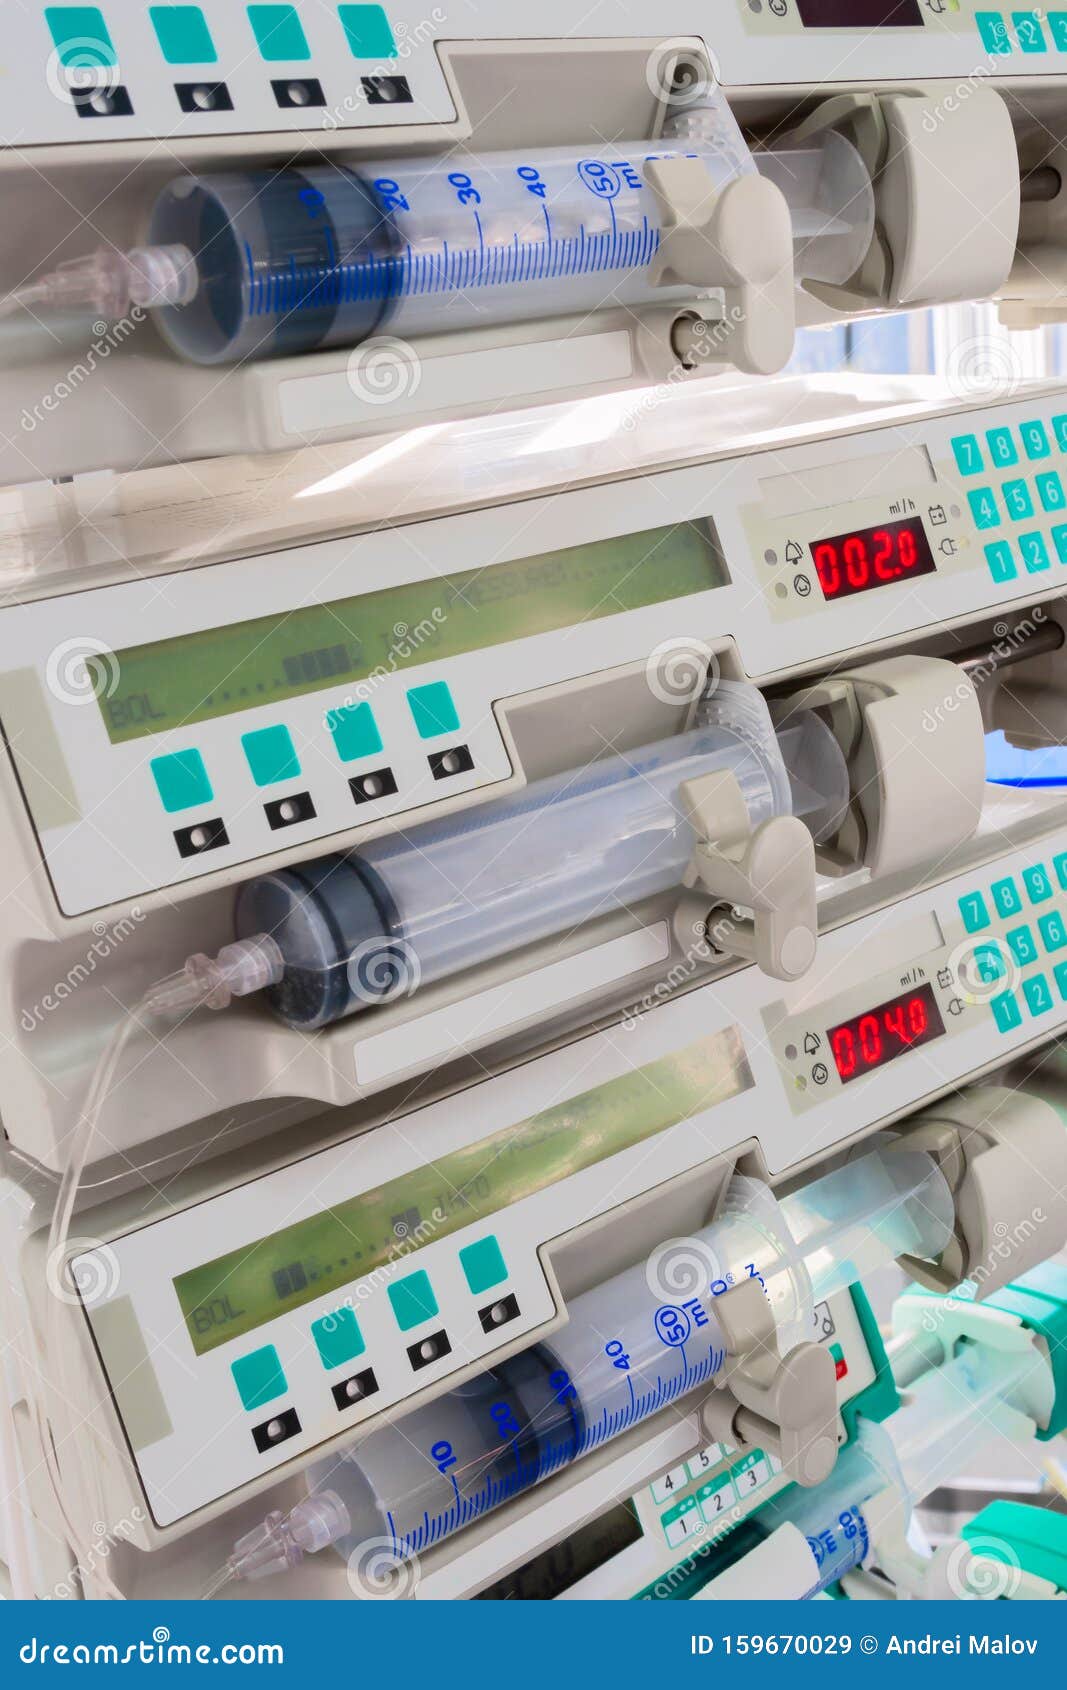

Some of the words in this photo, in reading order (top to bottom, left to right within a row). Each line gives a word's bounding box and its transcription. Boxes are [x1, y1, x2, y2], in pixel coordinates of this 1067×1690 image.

[448, 172, 481, 205] 30
[517, 166, 547, 198] 40
[584, 162, 615, 193] 50
[611, 162, 643, 189] ml
[373, 178, 410, 211] 20
[961, 443, 973, 467] 7
[996, 436, 1011, 459] 8
[1029, 428, 1044, 452] 9
[980, 497, 993, 520] 4
[1012, 488, 1026, 512] 5
[1045, 480, 1060, 504] 6
[814, 529, 918, 594] 002.0
[995, 551, 1007, 574] 1
[1029, 541, 1043, 565] 2
[967, 901, 979, 924] 7
[1001, 886, 1014, 909] 8
[1031, 873, 1046, 895] 9
[1016, 935, 1030, 958] 5
[1047, 920, 1061, 943] 6
[1001, 1000, 1012, 1022] 1
[1032, 984, 1046, 1007] 2
[191, 1294, 246, 1335] BOL
[659, 1310, 686, 1343] 50
[681, 1297, 710, 1328] ml
[605, 1340, 631, 1370] 40
[489, 1401, 521, 1439] 20
[430, 1440, 458, 1475] 10
[665, 1474, 674, 1490] 4
[699, 1450, 710, 1467] 5
[679, 1519, 688, 1535] 1
[713, 1494, 724, 1512] 2
[747, 1470, 757, 1487] 3
